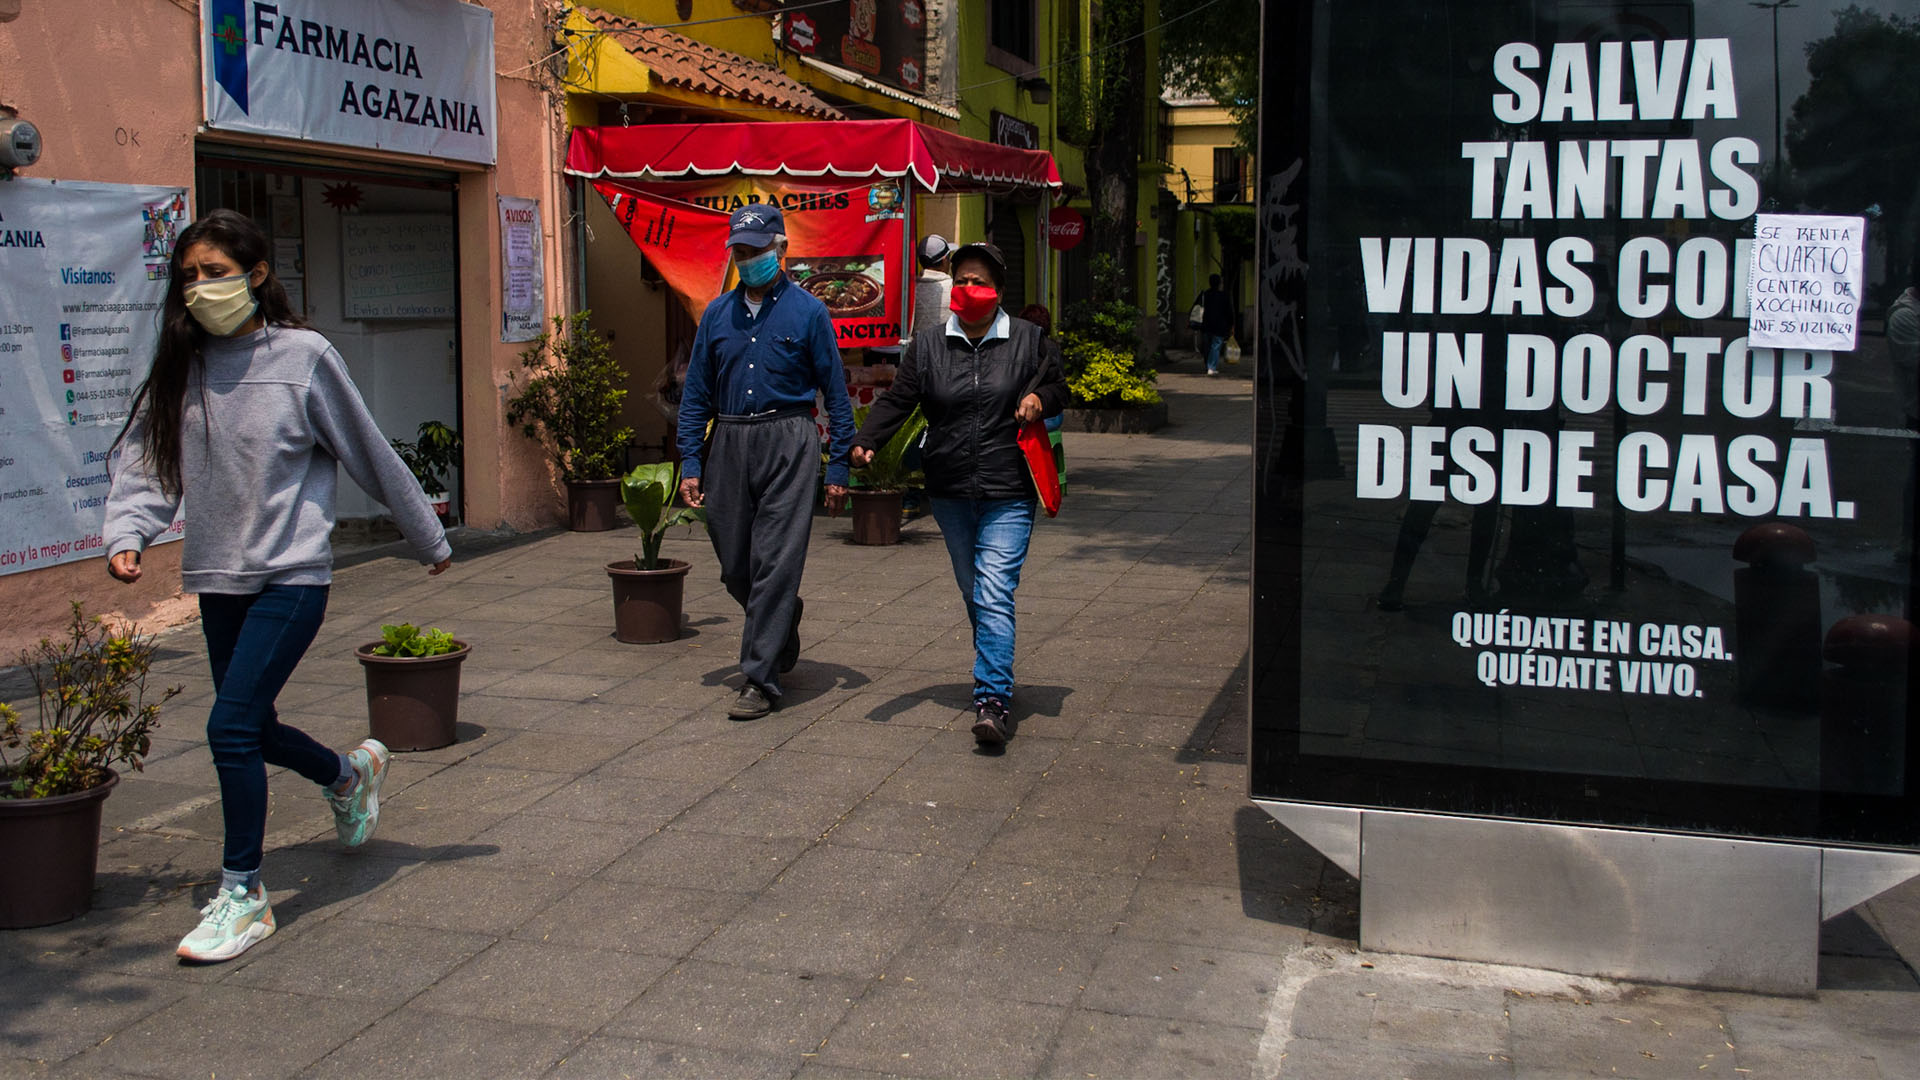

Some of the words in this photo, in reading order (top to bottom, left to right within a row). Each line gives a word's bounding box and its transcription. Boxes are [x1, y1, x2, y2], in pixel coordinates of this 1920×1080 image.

[253, 1, 422, 79] FARMACIA
[1492, 38, 1738, 123] SALVA
[339, 80, 485, 136] AGAZANIA
[115, 127, 140, 147] OK
[1461, 136, 1759, 220] TANTAS
[1760, 227, 1781, 239] SE
[1797, 228, 1850, 241] RENTA
[1758, 243, 1848, 274] CUARTO
[61, 267, 116, 285] Visítanos:
[1360, 236, 1594, 319] VIDAS
[1757, 278, 1822, 296] CENTRO
[1833, 282, 1852, 296] DE
[62, 301, 162, 314] www.farmaciaagazania.com.
[1756, 298, 1853, 315] XOCHIMILCO
[24, 325, 34, 334] pm
[834, 323, 900, 339] NCITA
[12, 344, 22, 353] pm
[1382, 332, 1481, 409] UN
[1505, 333, 1833, 419] DOCTOR
[66, 473, 111, 489] descuento
[1356, 423, 1594, 509] DESDE
[1617, 431, 1855, 519] CASA.
[3, 488, 28, 500] mucho
[79, 496, 102, 509] todas
[20, 550, 26, 565] y
[28, 545, 38, 560] la
[41, 540, 71, 559] mejor
[74, 535, 103, 551] calida
[1452, 609, 1585, 650] QUÉDATE
[1593, 620, 1630, 654] EN
[1639, 623, 1733, 661] CASA.
[1477, 648, 1611, 691] QUÉDATE
[1619, 660, 1703, 698] VIVO.
